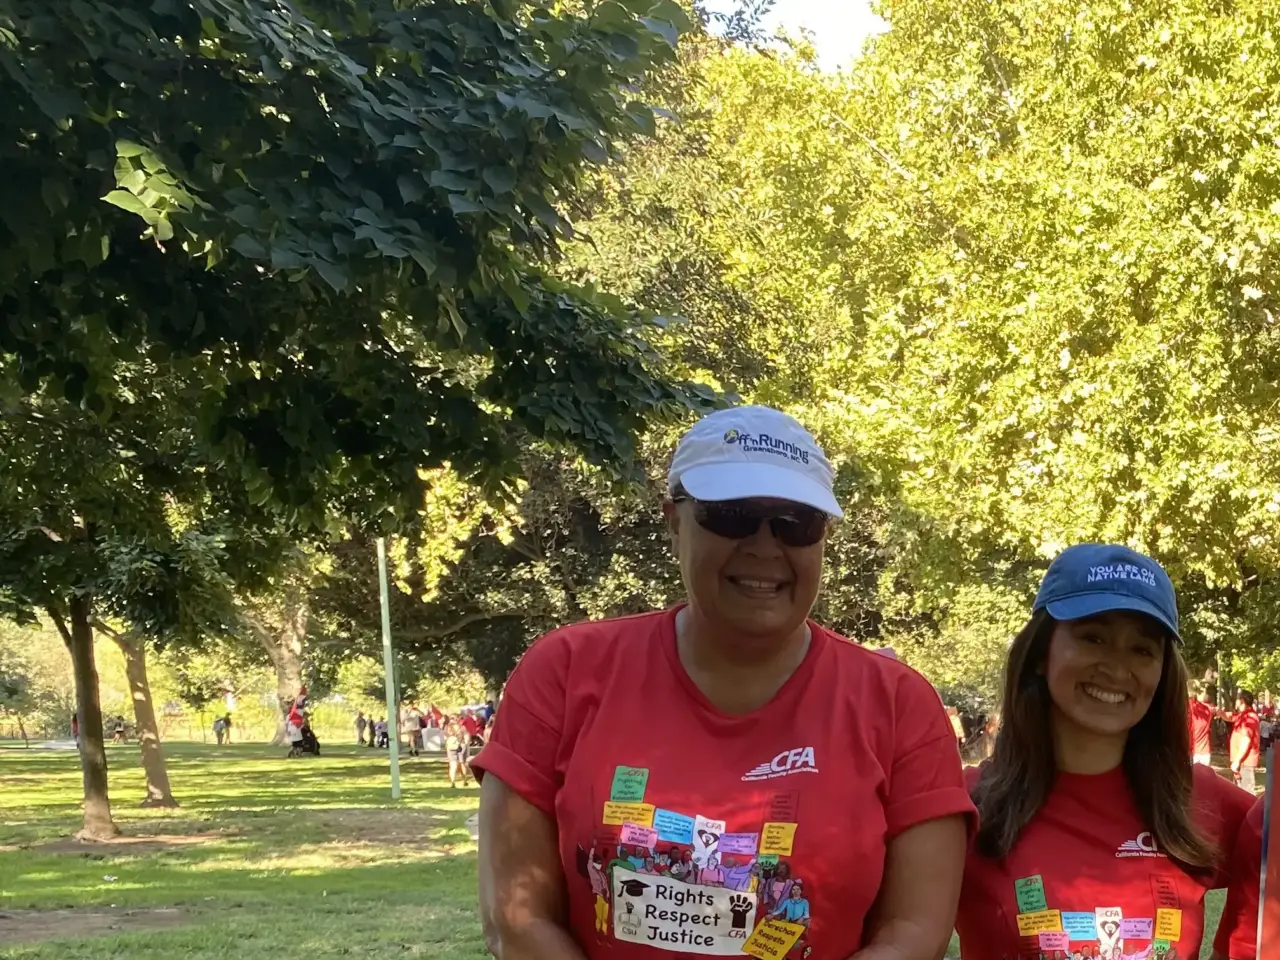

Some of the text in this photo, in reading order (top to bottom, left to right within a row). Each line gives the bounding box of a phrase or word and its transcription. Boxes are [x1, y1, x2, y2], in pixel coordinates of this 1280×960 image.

[759, 434, 809, 465] Running
[791, 455, 801, 463] NC
[1088, 571, 1156, 587] NATIVE LAND
[1090, 564, 1155, 579] YOU ARE ON
[771, 747, 815, 771] CFA
[705, 820, 722, 832] CFA
[655, 884, 715, 906] Rights
[645, 904, 721, 927] Respect
[1105, 910, 1120, 918] CFA
[647, 925, 715, 947] Justice
[728, 929, 747, 940] CFA
[751, 938, 778, 956] Justicia
